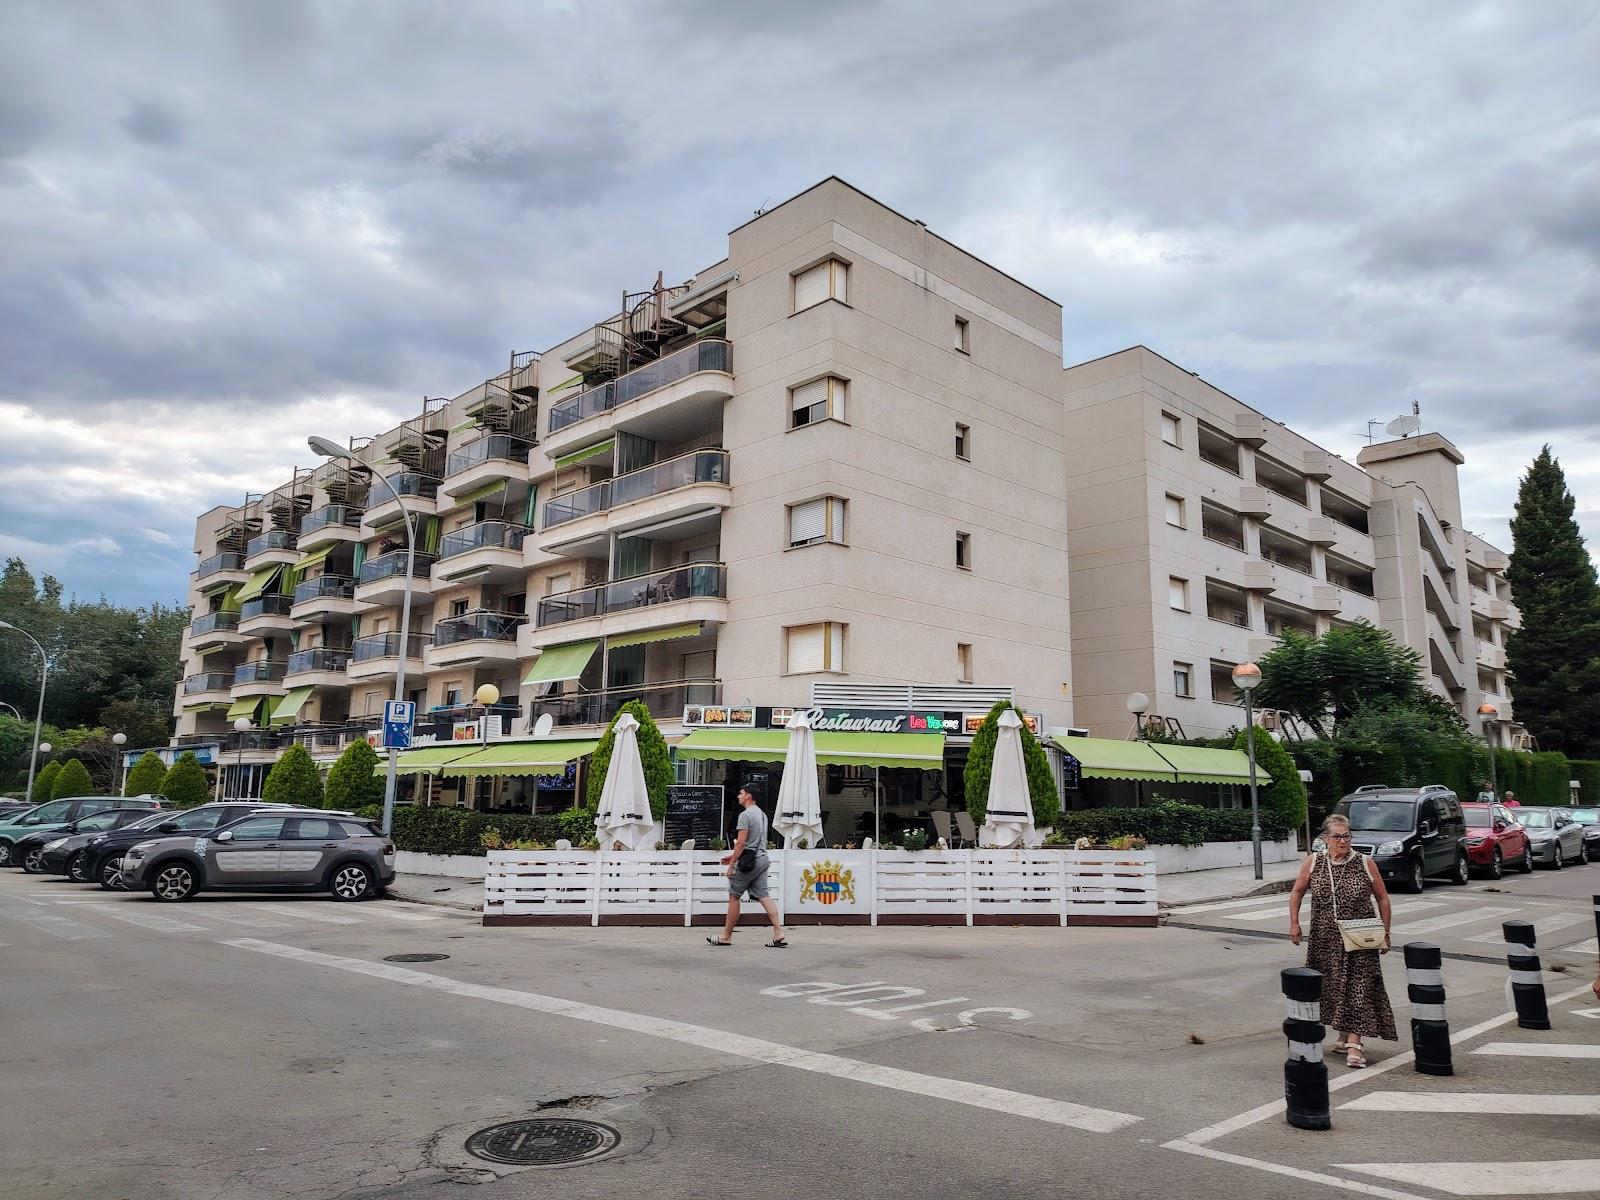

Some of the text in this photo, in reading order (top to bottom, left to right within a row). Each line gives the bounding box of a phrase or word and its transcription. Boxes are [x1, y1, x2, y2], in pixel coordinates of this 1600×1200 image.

[396, 705, 403, 713] P
[807, 707, 906, 732] Restaurant
[910, 715, 927, 729] Los
[759, 981, 1034, 1032] STOP
